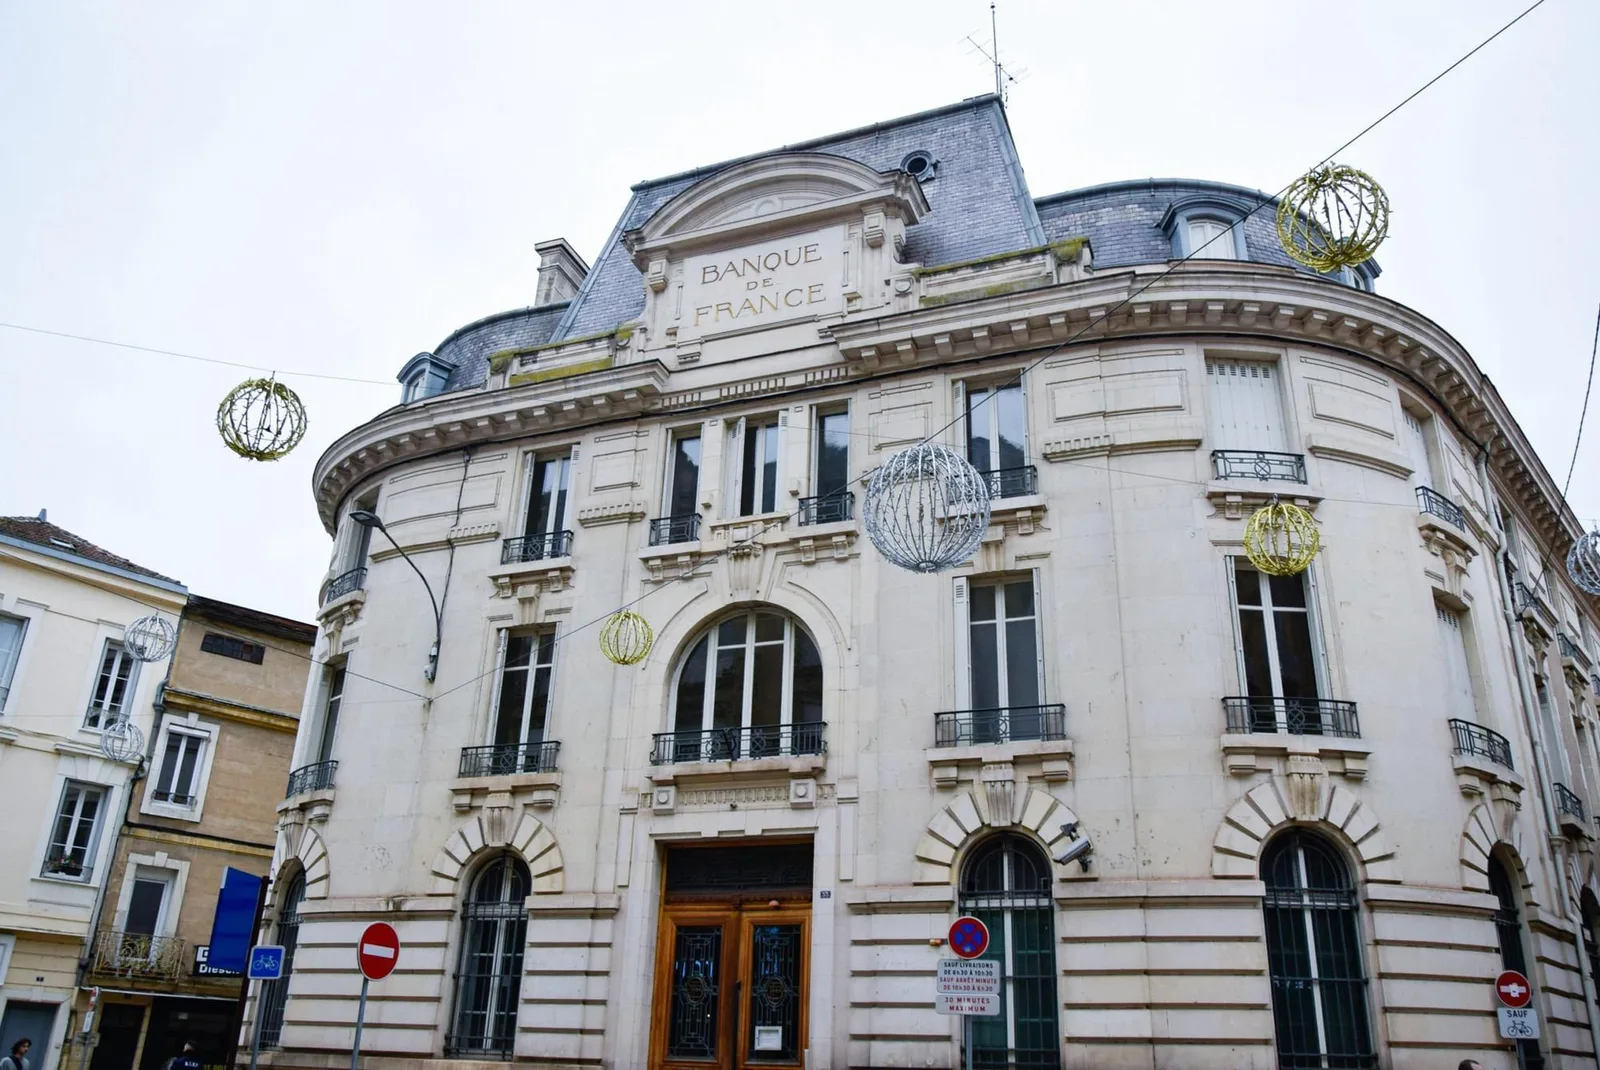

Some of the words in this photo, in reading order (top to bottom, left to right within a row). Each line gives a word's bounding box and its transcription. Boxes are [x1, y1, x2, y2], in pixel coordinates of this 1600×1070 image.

[701, 243, 822, 285] BANQUE
[746, 277, 774, 291] DE
[693, 283, 827, 327] FRANCE
[1506, 1009, 1528, 1018] SAUF
